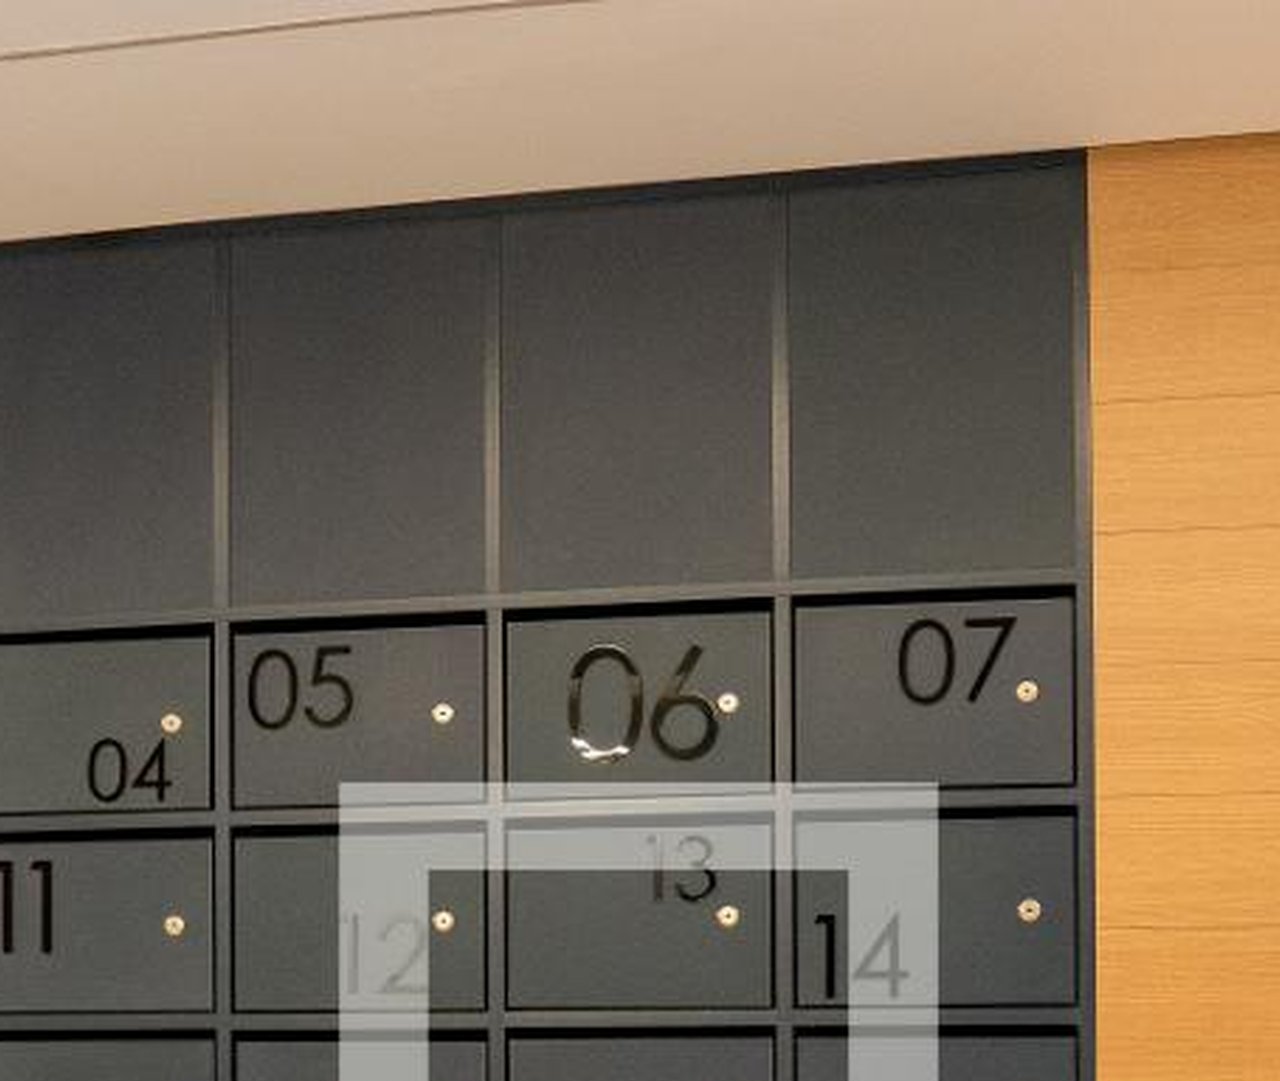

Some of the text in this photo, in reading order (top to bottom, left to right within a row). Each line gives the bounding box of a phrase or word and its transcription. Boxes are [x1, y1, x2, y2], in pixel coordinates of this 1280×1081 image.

[248, 645, 354, 730] 05
[568, 643, 719, 761] 06
[898, 617, 1017, 706] 07
[88, 737, 172, 802] 04
[646, 833, 717, 902] 13
[341, 912, 427, 995] 12
[815, 912, 910, 999] 14
